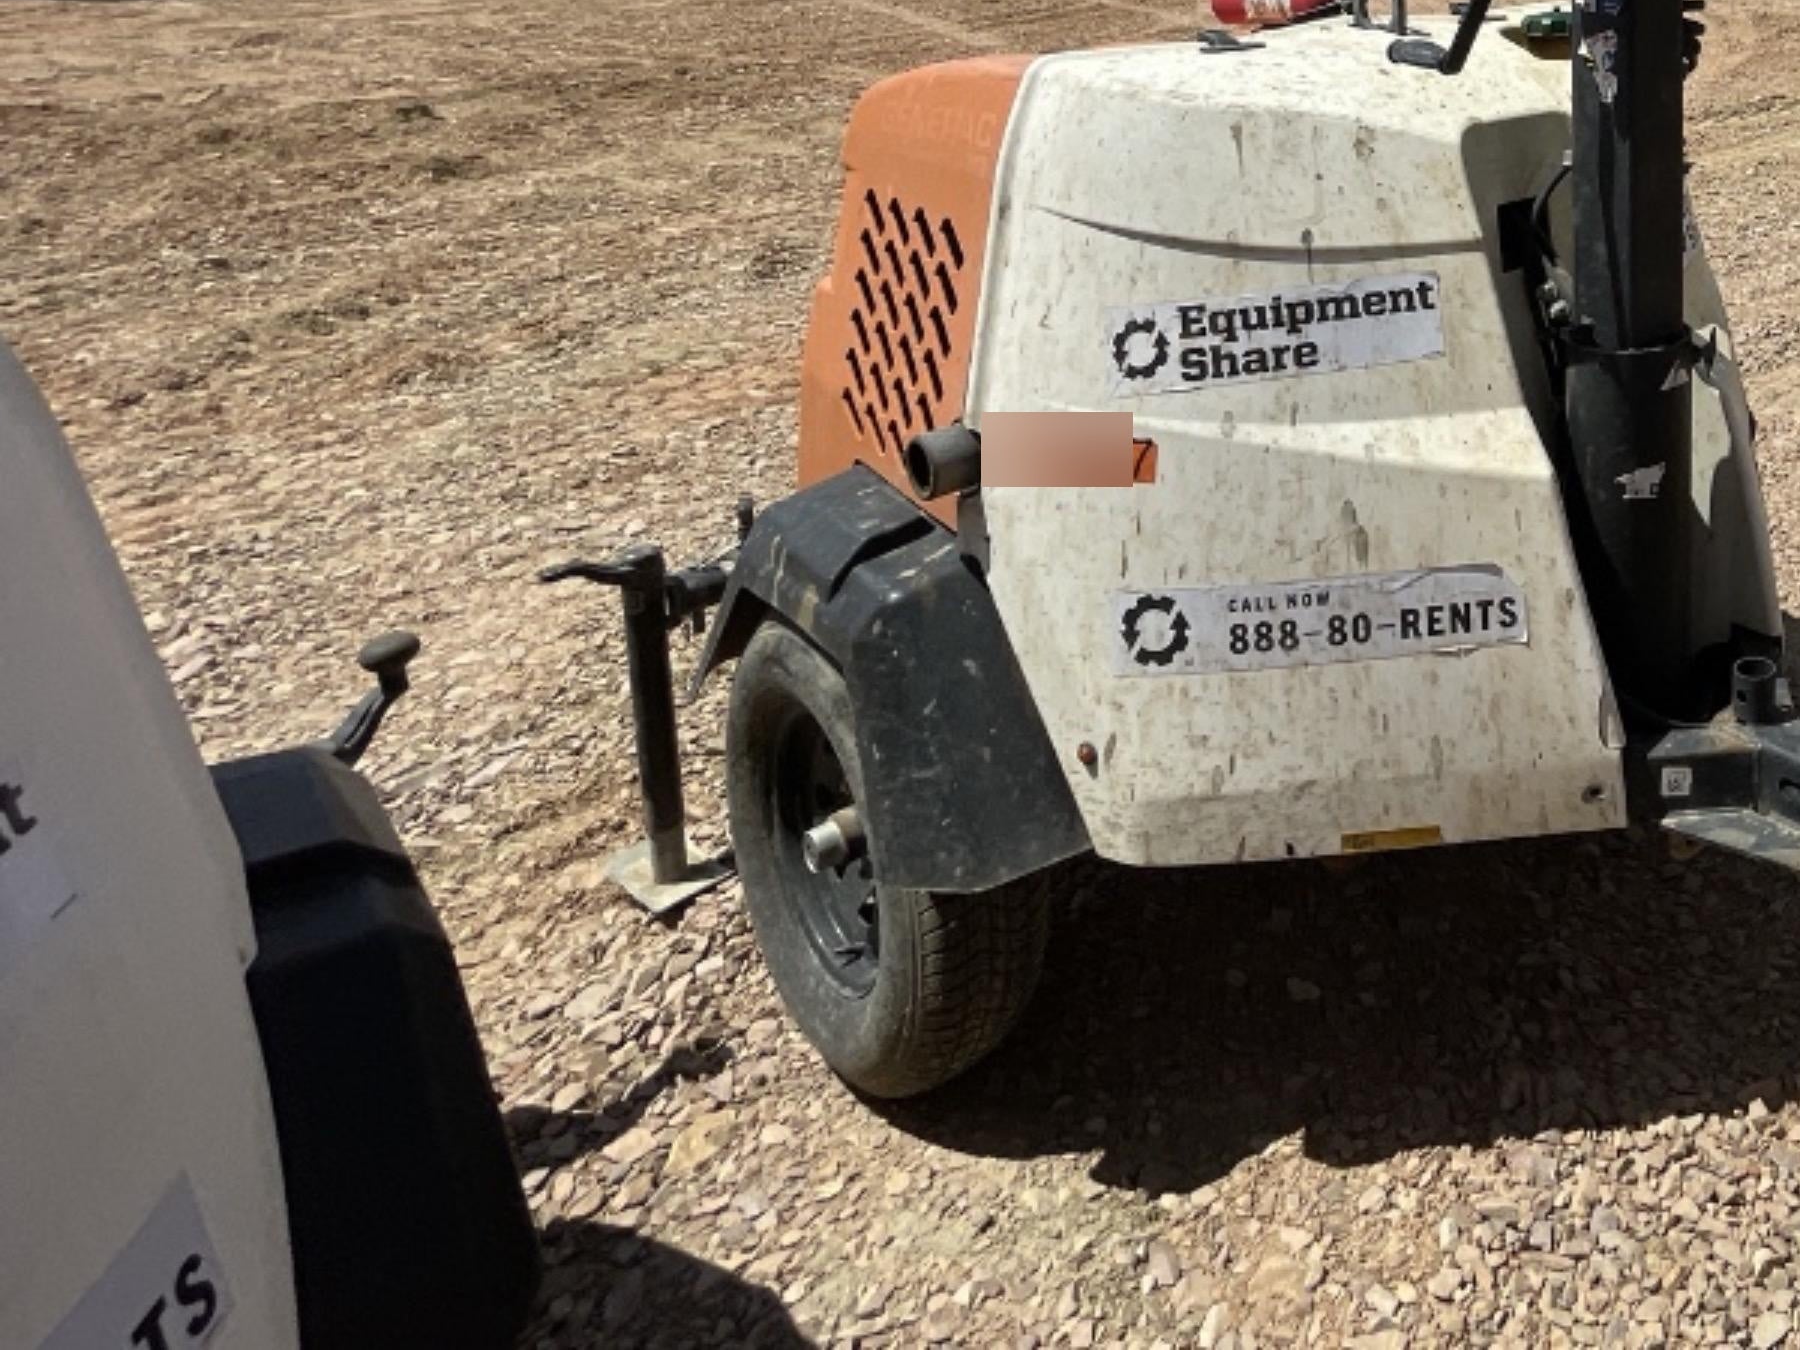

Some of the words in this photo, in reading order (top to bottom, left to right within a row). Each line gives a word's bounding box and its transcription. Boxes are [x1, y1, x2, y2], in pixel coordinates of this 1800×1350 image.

[1177, 281, 1436, 342] Equipment
[1179, 340, 1320, 381] Share
[1227, 596, 1277, 613] CALL
[1286, 590, 1330, 610] NOW
[1229, 596, 1519, 655] 888-80-RENTS
